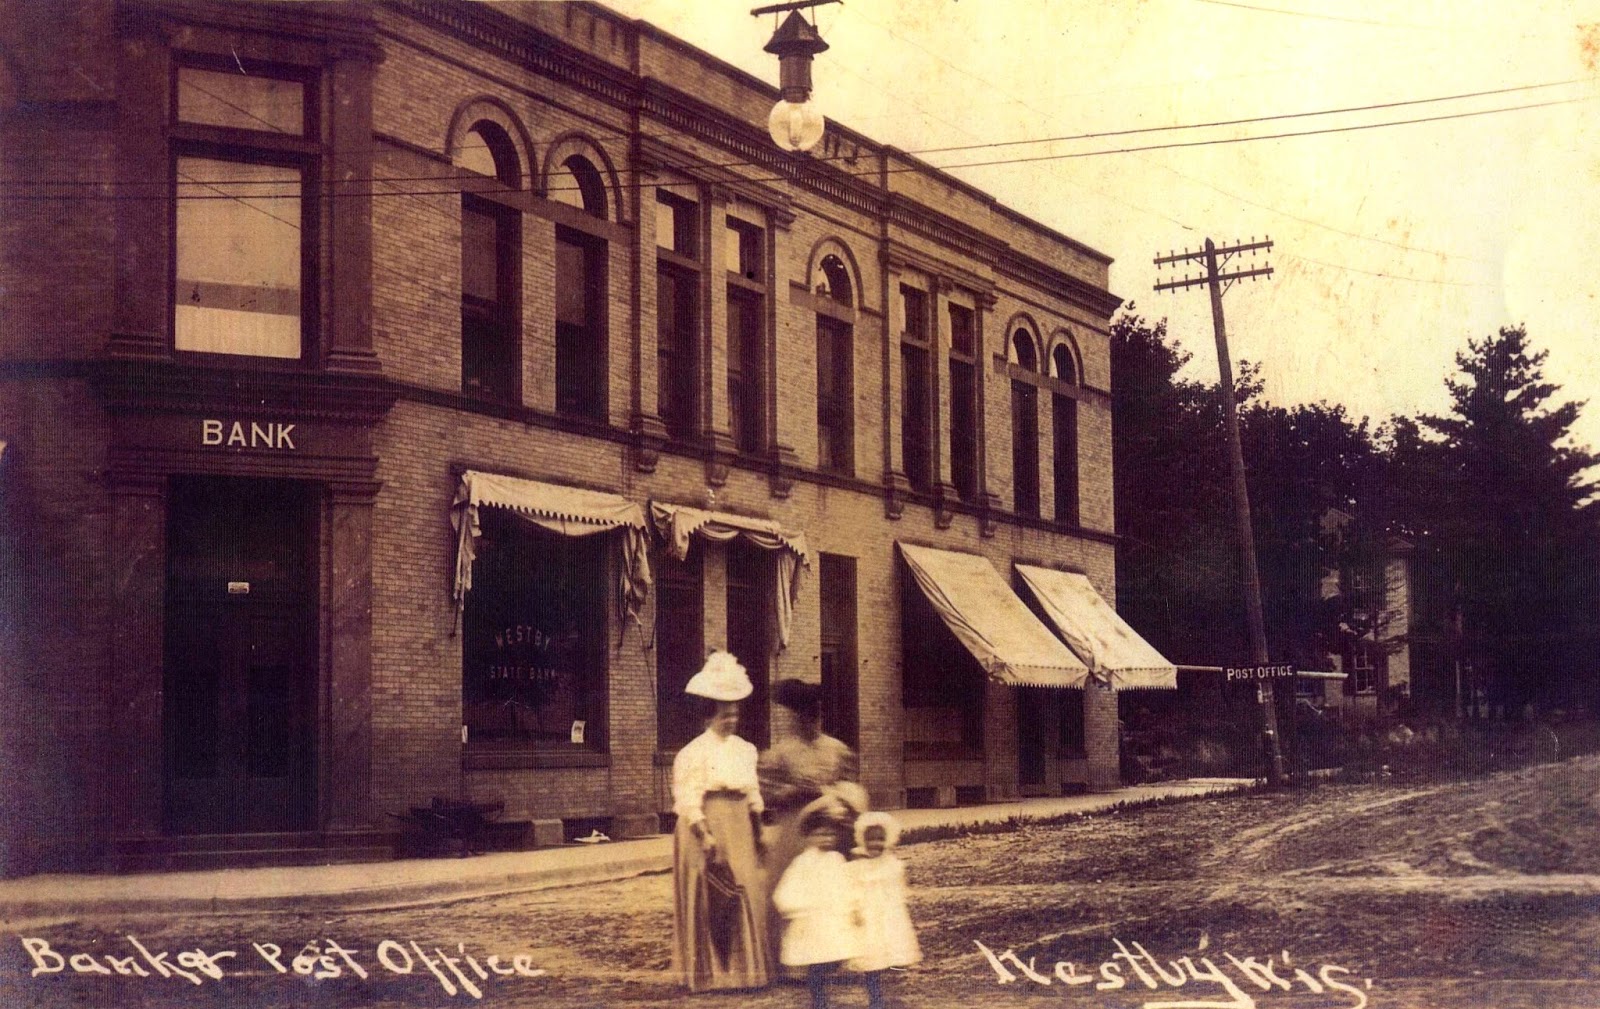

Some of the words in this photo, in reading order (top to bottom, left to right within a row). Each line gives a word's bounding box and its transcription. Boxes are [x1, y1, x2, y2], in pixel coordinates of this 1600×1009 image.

[201, 419, 296, 450] BANK
[494, 624, 551, 651] WESTBY
[1226, 667, 1254, 681] POST
[1257, 665, 1293, 679] OFFICE
